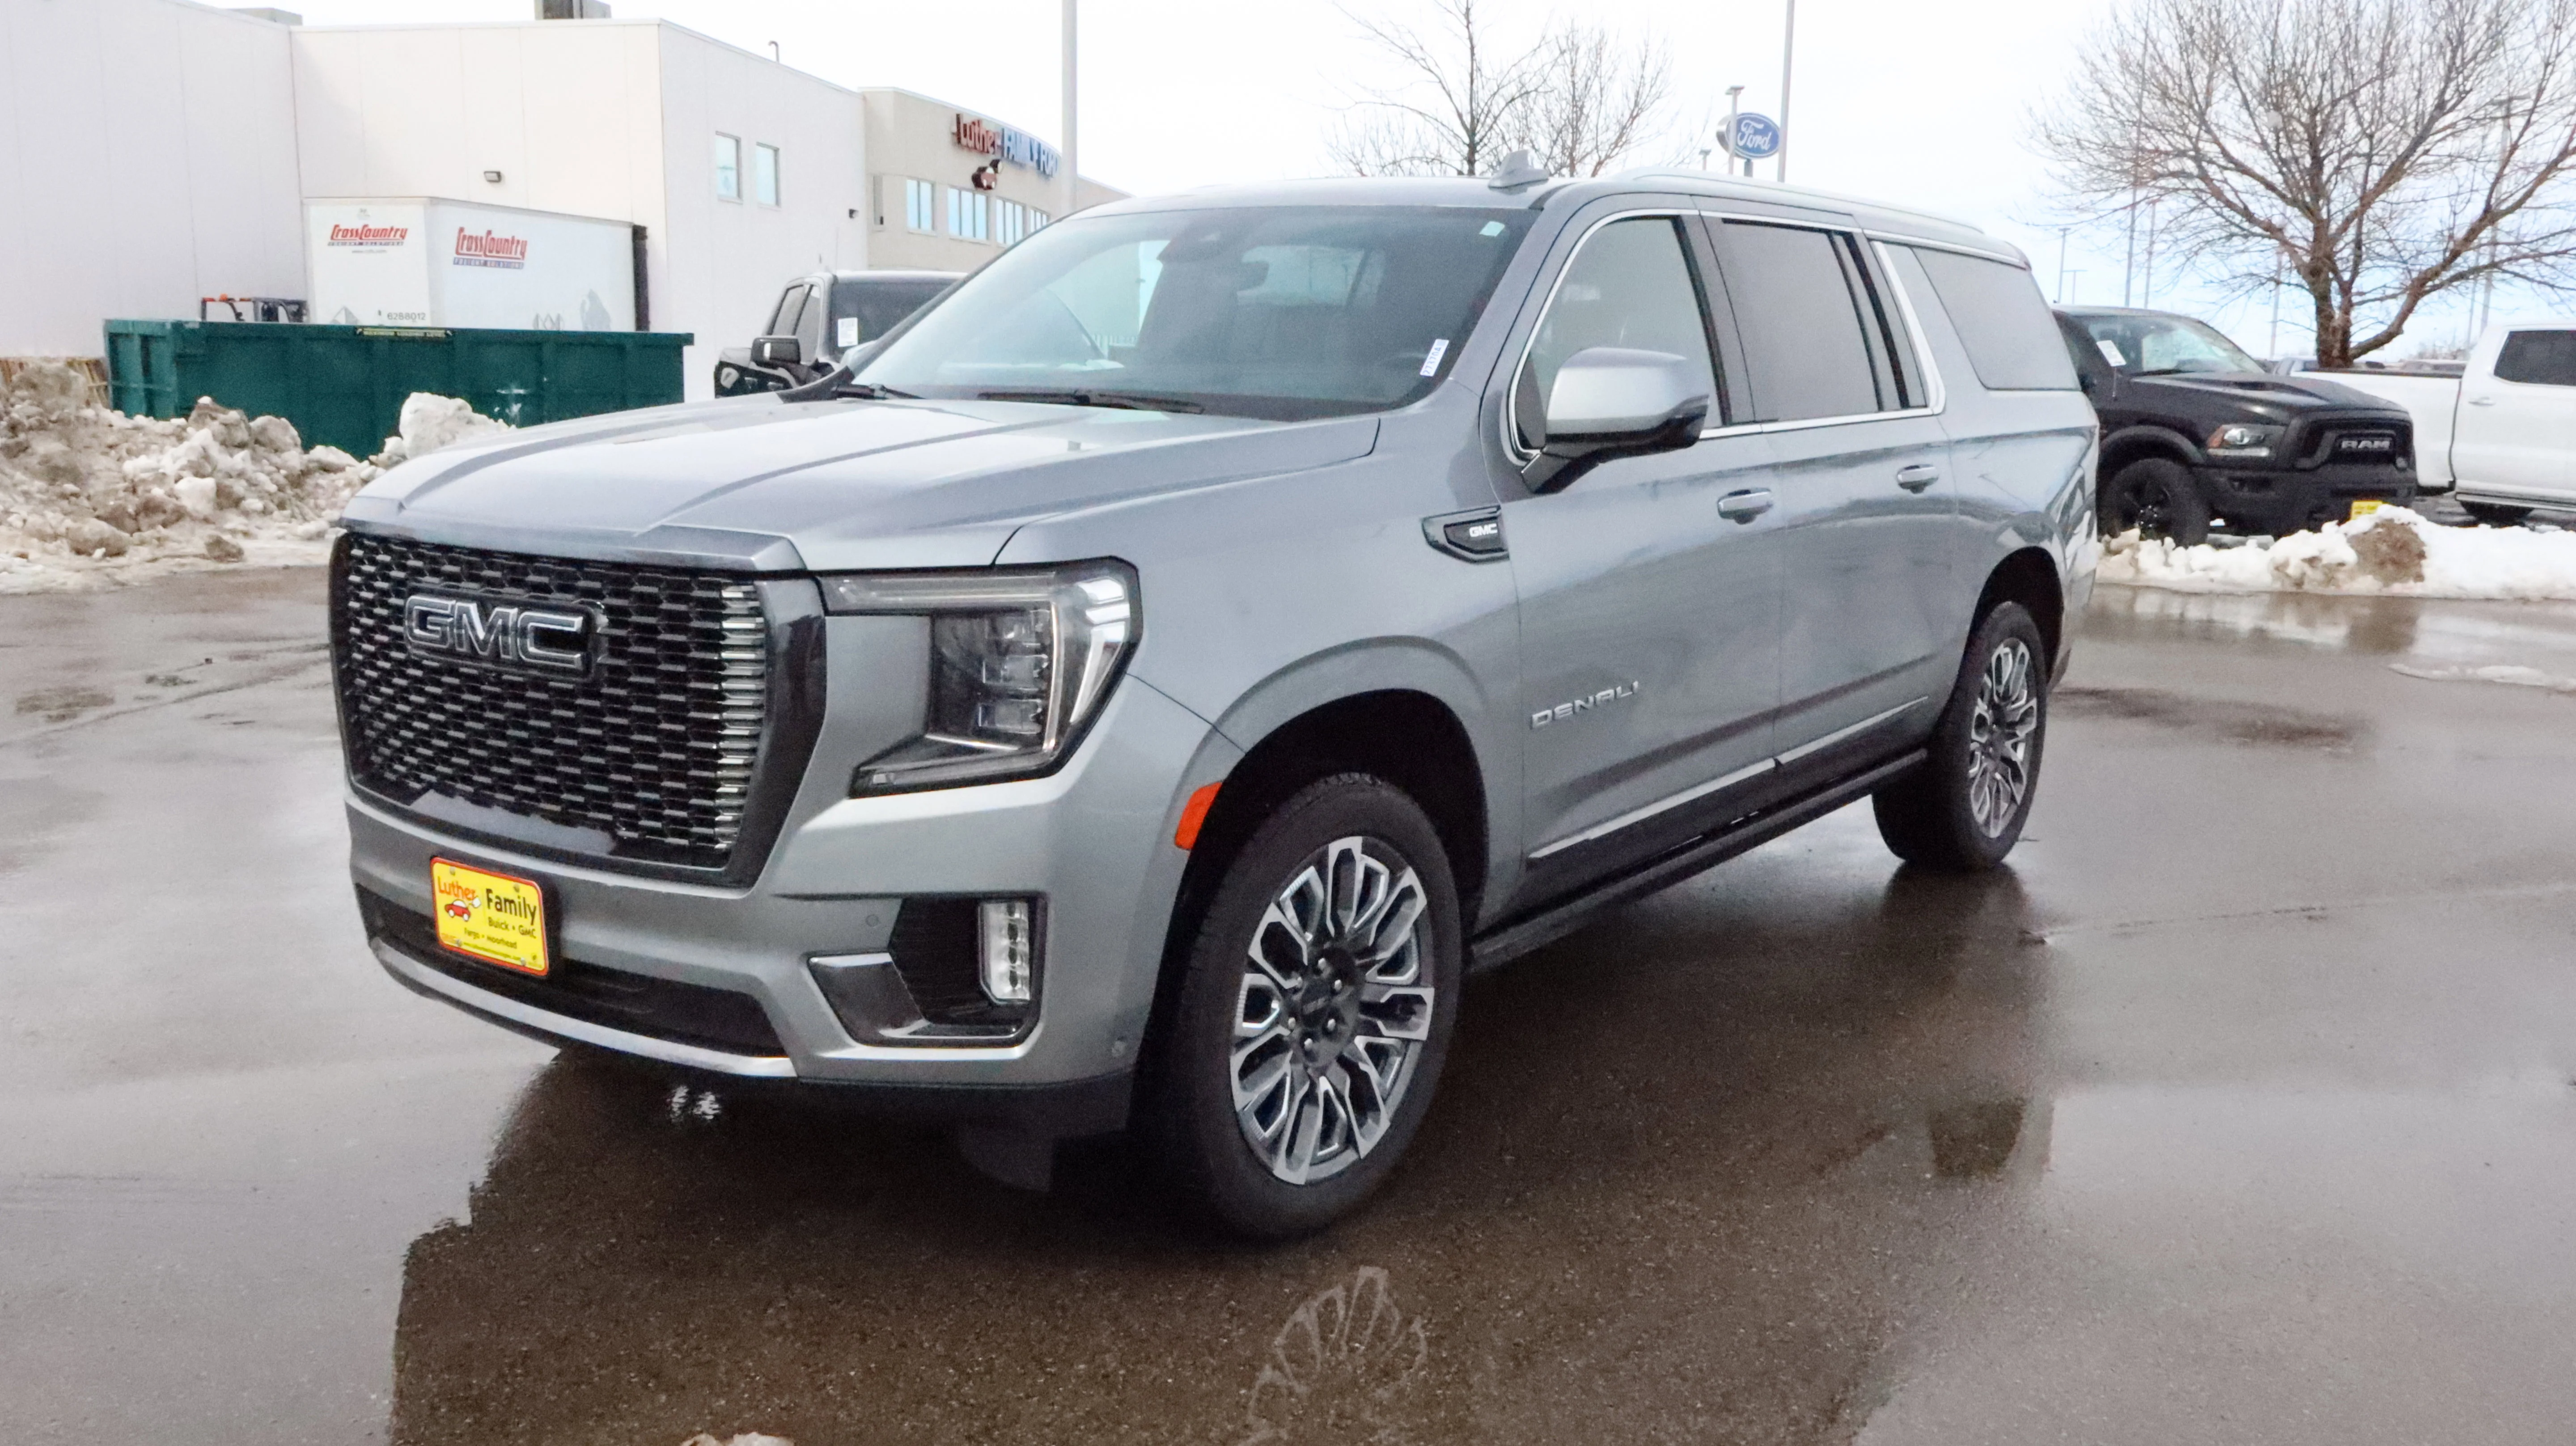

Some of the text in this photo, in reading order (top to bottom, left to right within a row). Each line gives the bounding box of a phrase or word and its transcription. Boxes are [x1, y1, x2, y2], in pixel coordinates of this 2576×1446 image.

[952, 113, 1000, 155] Luther
[1001, 128, 1038, 164] FAMILY
[1737, 119, 1772, 151] Ford
[387, 312, 426, 320] 6288012
[2341, 440, 2390, 450] RAM
[1469, 523, 1497, 537] GMC
[405, 595, 584, 670] GMC
[1530, 680, 1639, 729] DENALI
[438, 876, 476, 901] Luther
[486, 888, 537, 926] Family
[488, 916, 537, 939] Buick GMC
